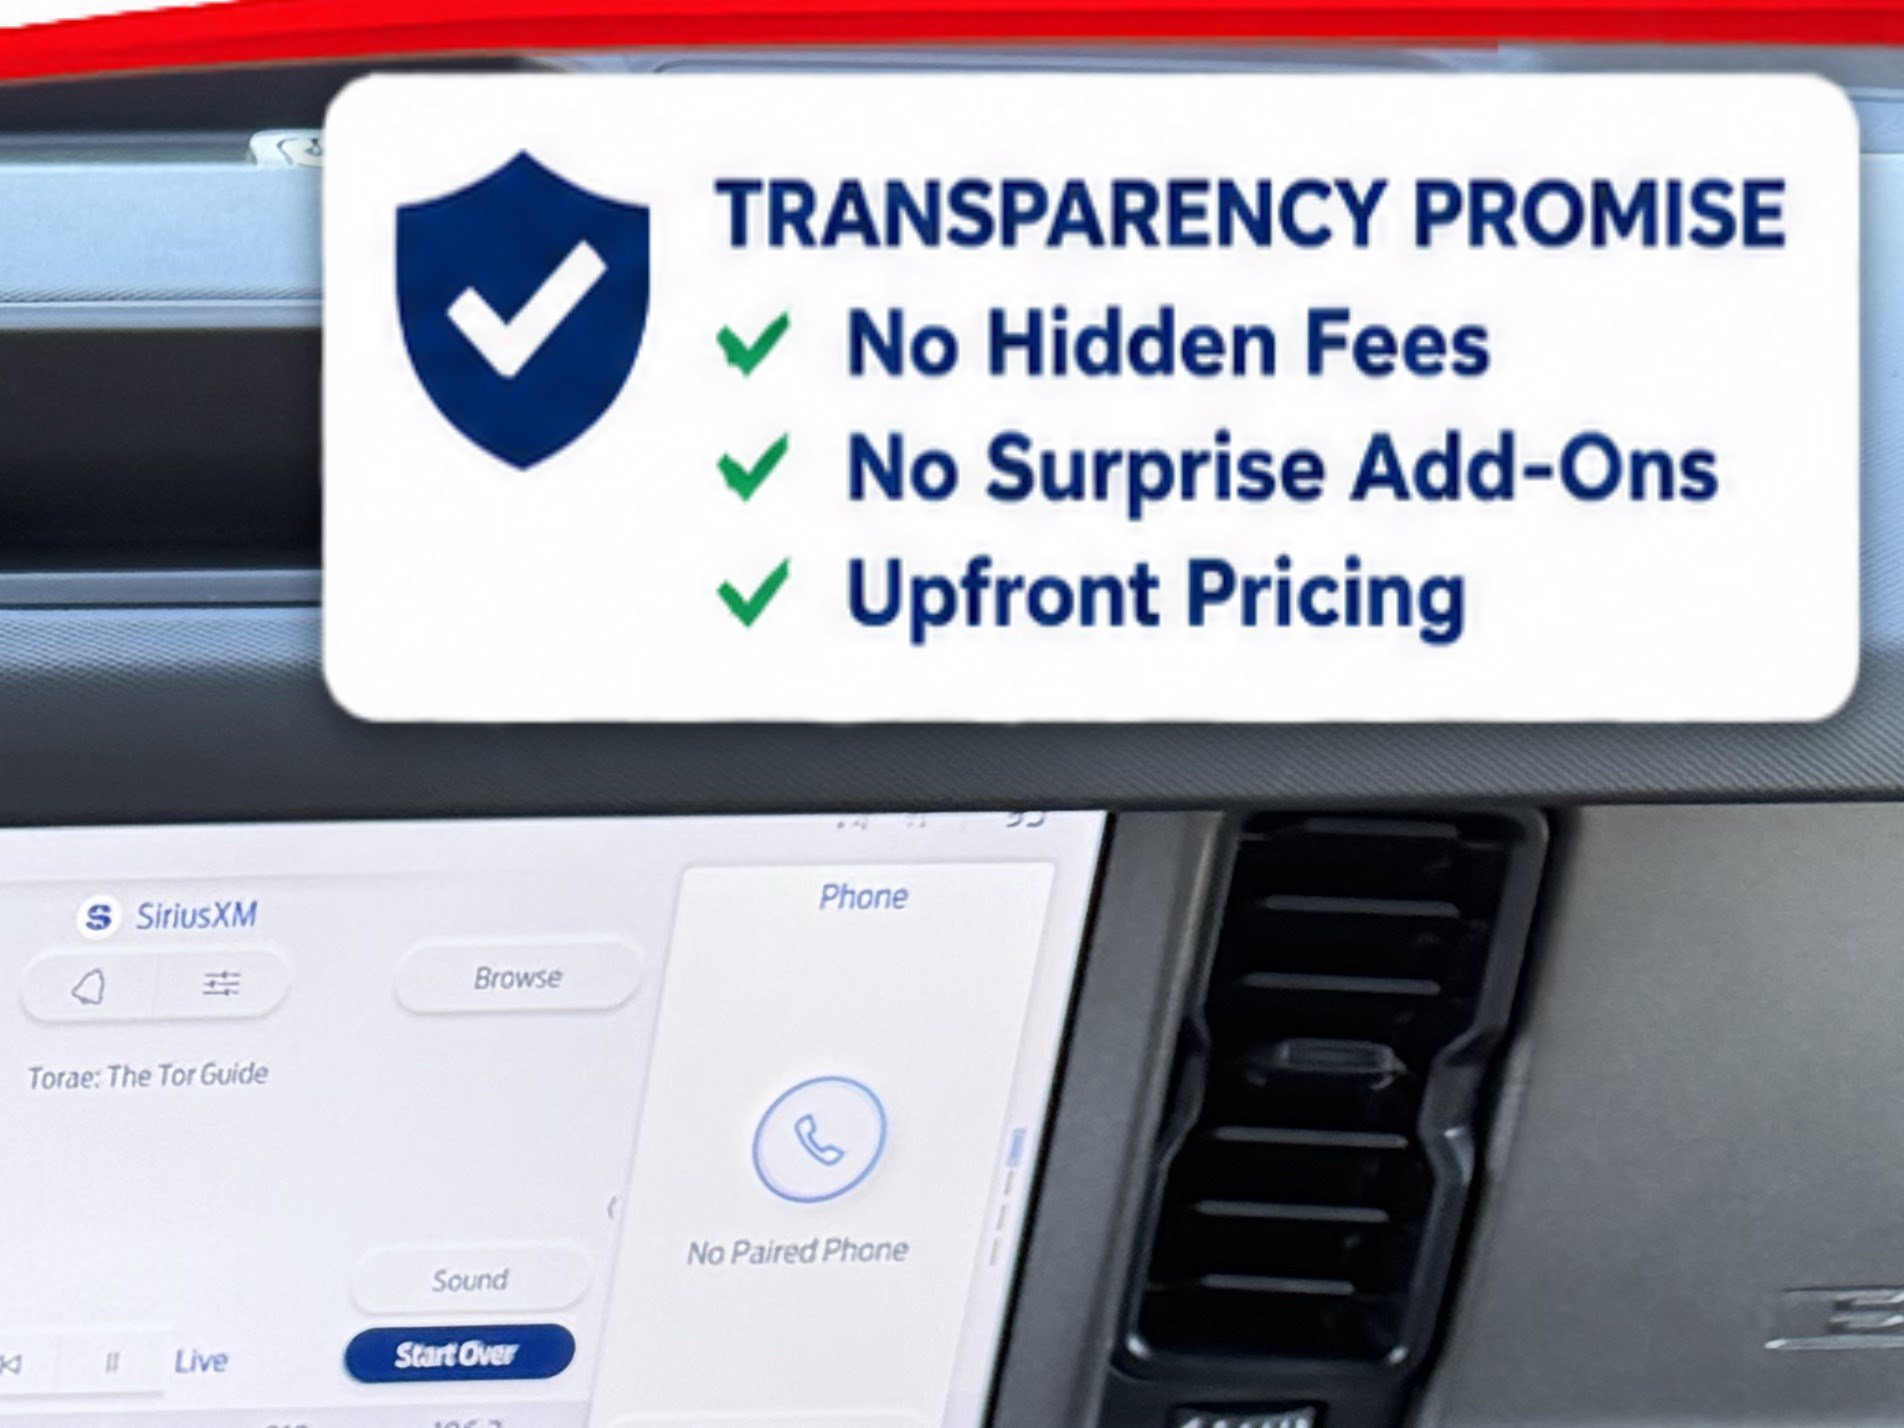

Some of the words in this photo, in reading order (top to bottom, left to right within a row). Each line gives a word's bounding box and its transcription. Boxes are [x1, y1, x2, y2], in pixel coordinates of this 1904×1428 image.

[817, 881, 910, 911] Phone
[136, 901, 259, 932] SiriusXM
[473, 964, 565, 992] Browse
[28, 1064, 102, 1091] Torae:
[106, 1063, 154, 1089] The
[156, 1062, 197, 1088] Tor
[199, 1061, 270, 1088] Guide
[686, 1239, 727, 1266] No
[730, 1237, 818, 1265] Paired
[821, 1236, 910, 1265] Phone
[431, 1267, 510, 1294] Sound
[173, 1347, 230, 1375] Live
[394, 1341, 456, 1369] Start
[458, 1341, 521, 1368] Over
